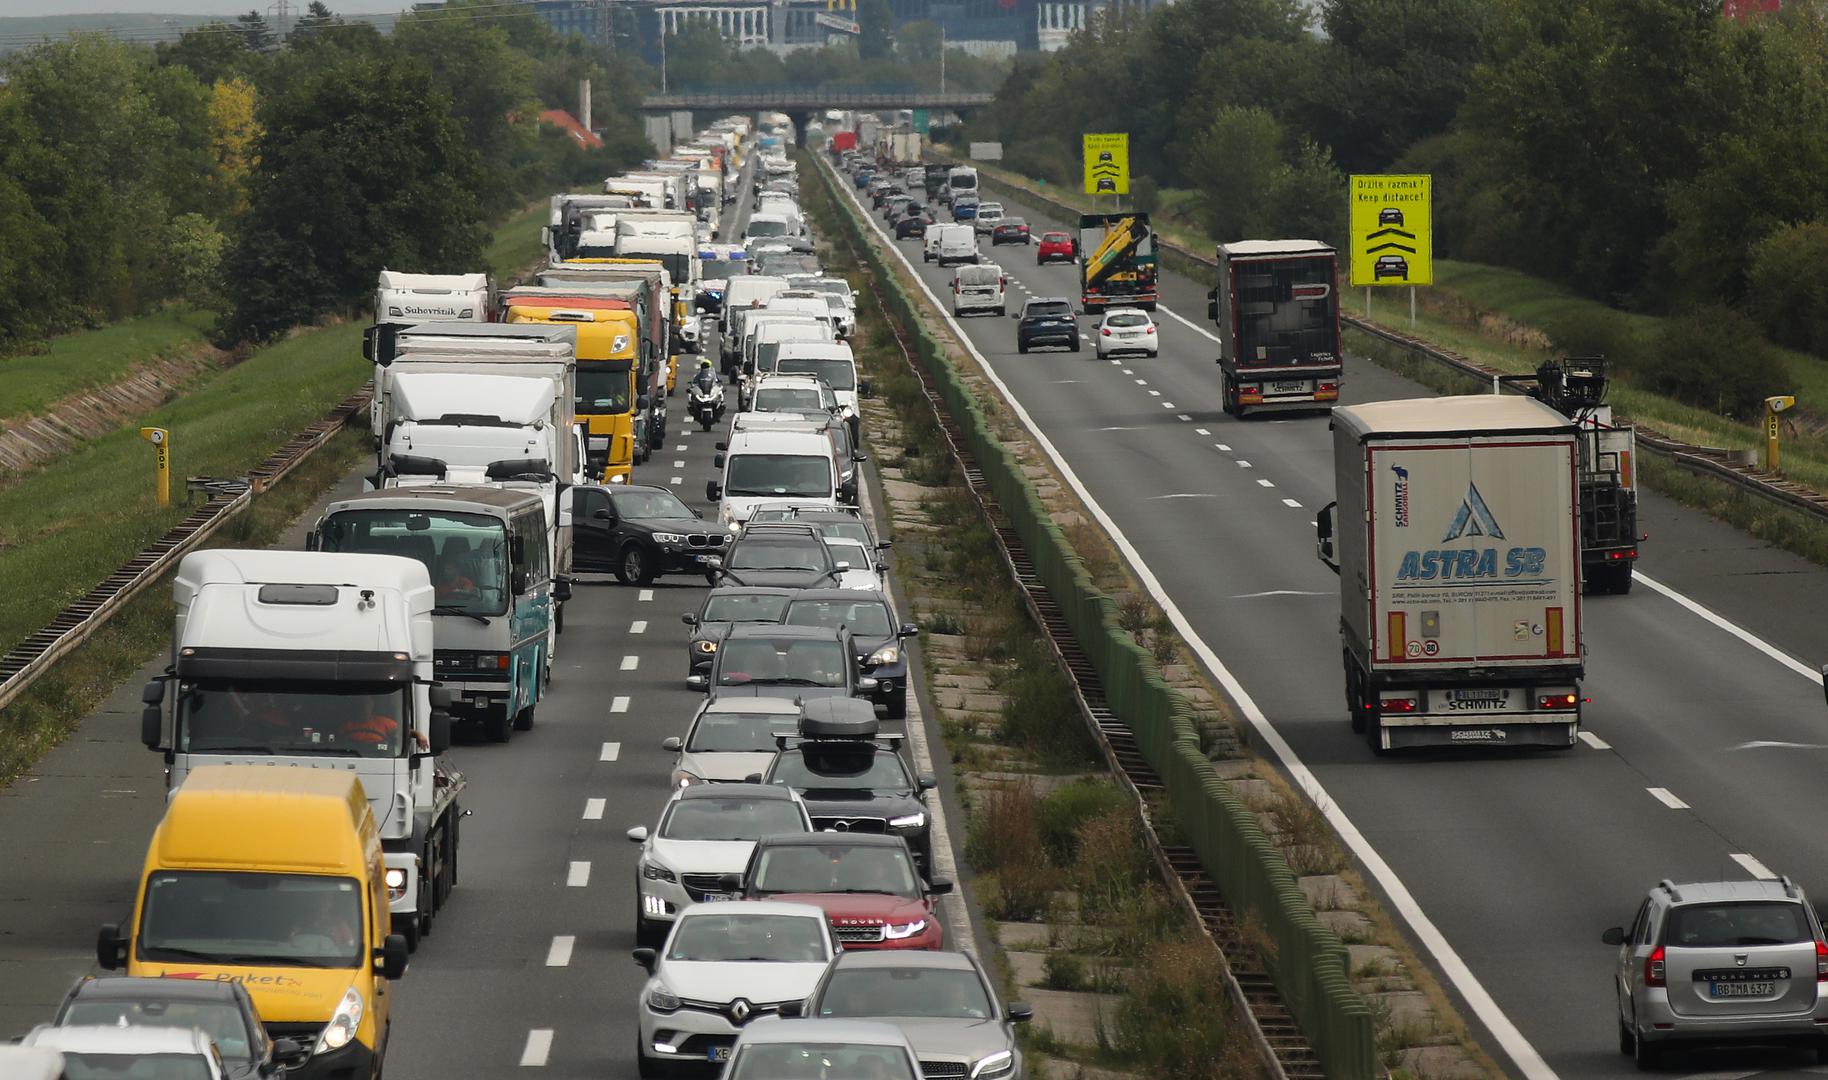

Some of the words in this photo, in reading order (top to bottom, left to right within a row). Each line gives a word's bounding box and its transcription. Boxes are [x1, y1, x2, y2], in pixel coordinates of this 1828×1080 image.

[1358, 193, 1379, 203] Keep
[1383, 192, 1424, 202] distance!
[404, 305, 456, 316] Suhovršnik
[1768, 416, 1777, 437] SOS
[1395, 482, 1403, 527] SCHMITZ
[1397, 548, 1498, 580] ASTRA
[1504, 547, 1547, 577] SB
[1409, 645, 1420, 653] 70
[1449, 700, 1506, 710] SCHMITZ
[1717, 984, 1730, 995] BB
[1736, 984, 1748, 994] MA
[1751, 983, 1775, 993] 6373
[715, 1048, 728, 1060] KE
